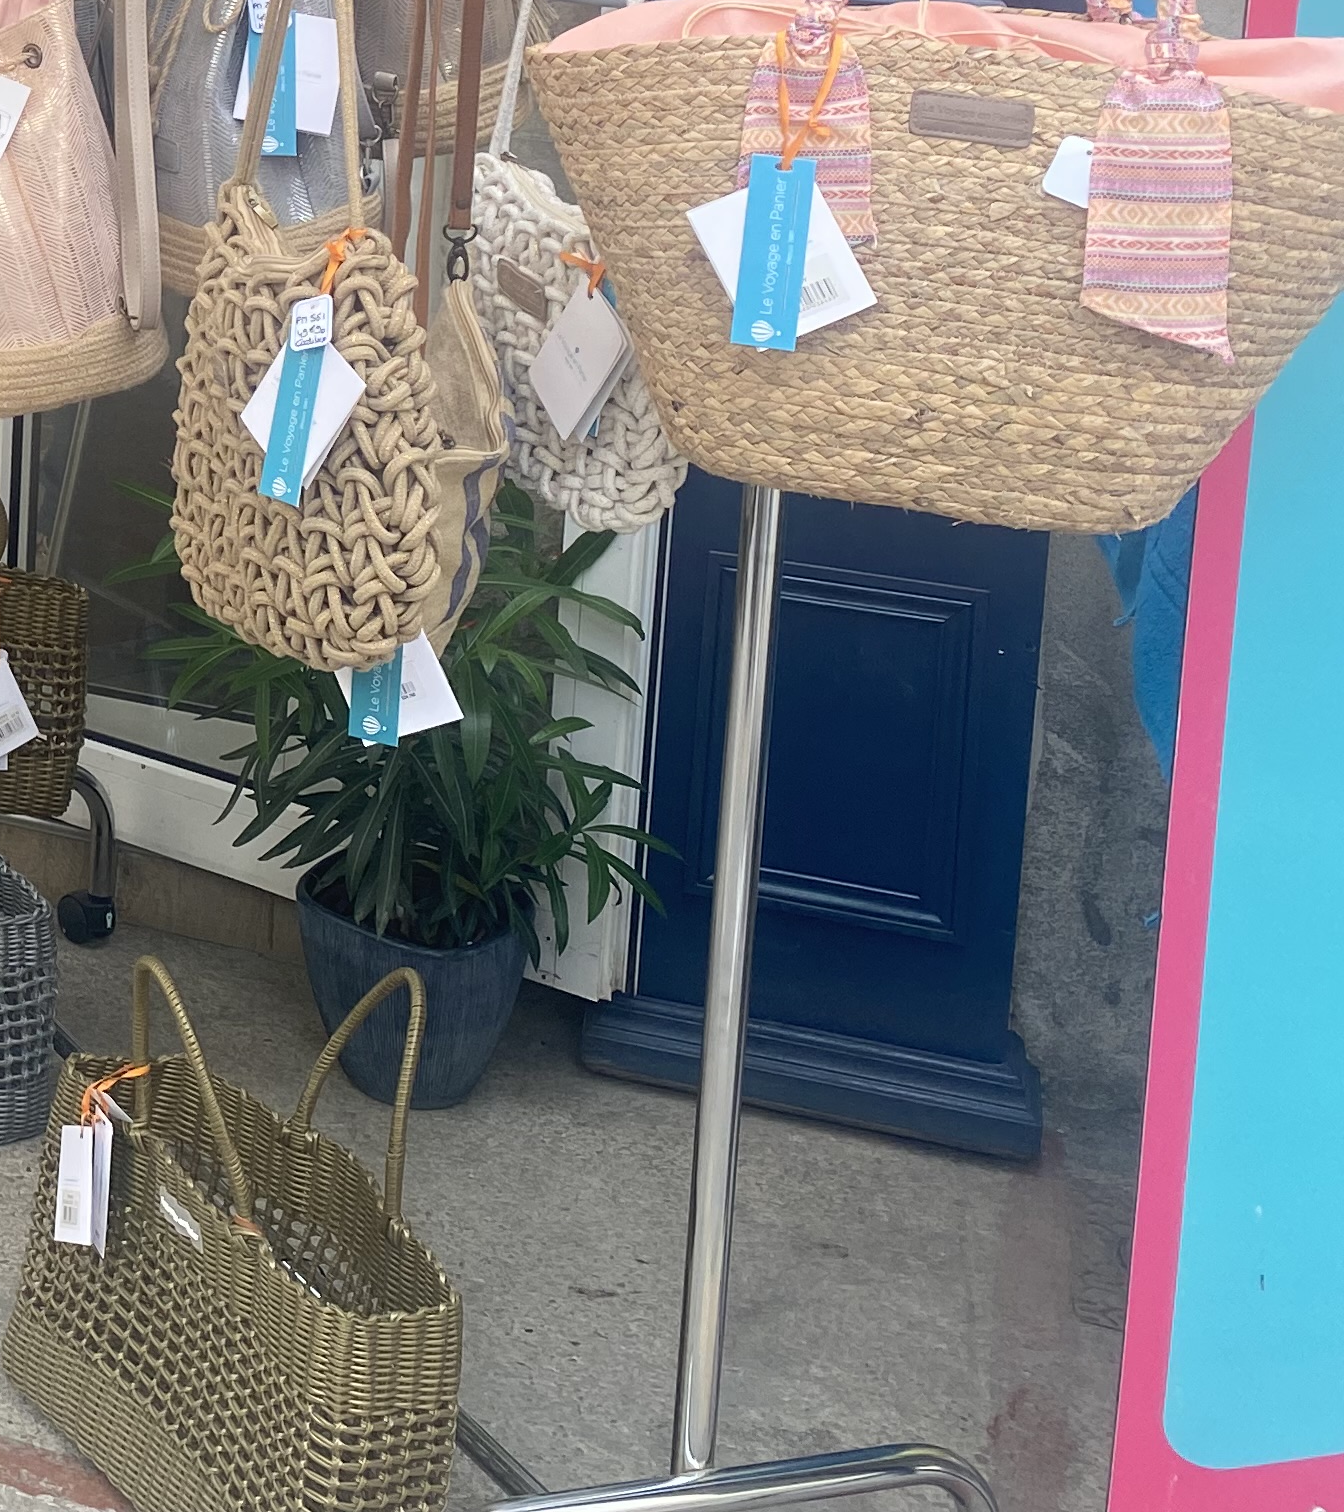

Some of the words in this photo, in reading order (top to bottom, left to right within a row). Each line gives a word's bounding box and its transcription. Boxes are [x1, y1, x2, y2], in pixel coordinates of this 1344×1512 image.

[770, 176, 788, 221] Panier
[773, 224, 782, 241] en
[762, 243, 781, 295] Voyage
[760, 297, 774, 315] Le
[292, 390, 302, 406] en
[283, 408, 299, 454] Voyage
[278, 455, 289, 473] Le
[369, 696, 380, 713] Le
